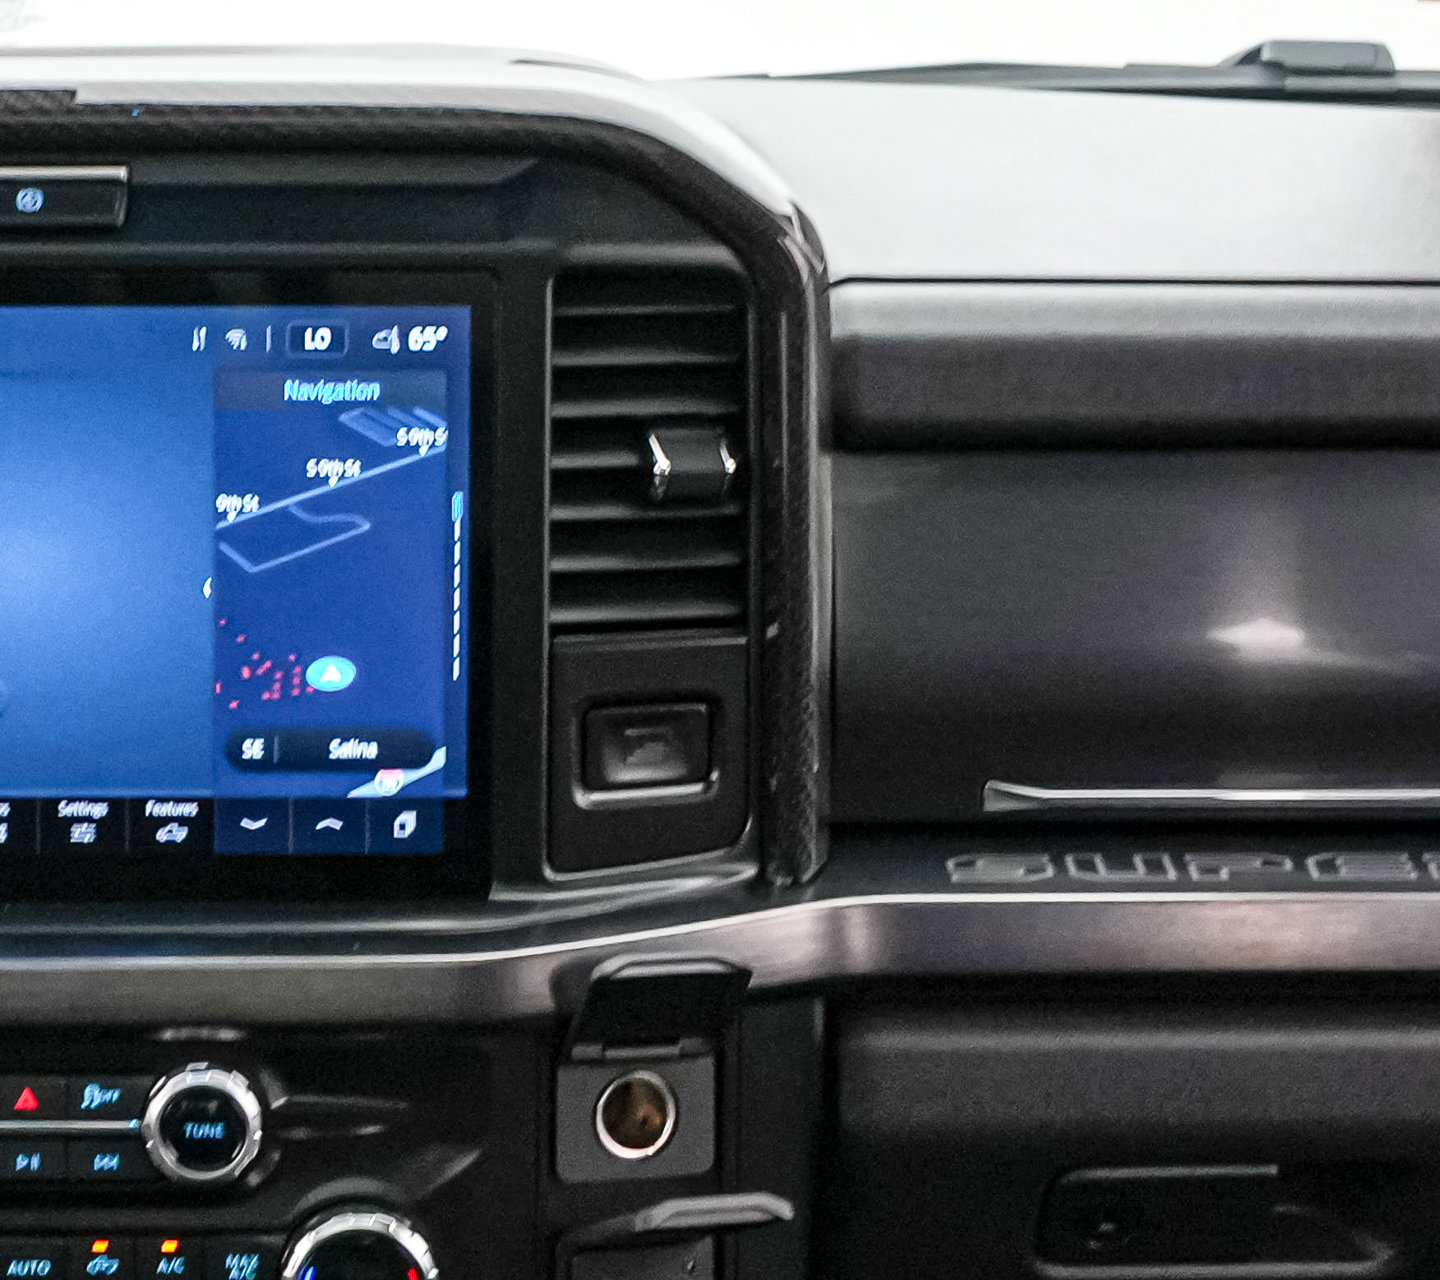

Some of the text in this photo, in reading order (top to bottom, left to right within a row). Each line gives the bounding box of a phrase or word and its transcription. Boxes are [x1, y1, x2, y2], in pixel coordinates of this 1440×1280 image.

[303, 326, 333, 351] LO
[283, 379, 381, 405] Navigation
[57, 800, 109, 820] Settings
[144, 800, 199, 818] Features
[184, 1122, 225, 1140] TUNE
[7, 1259, 52, 1277] AUTO
[156, 1257, 186, 1275] A/C
